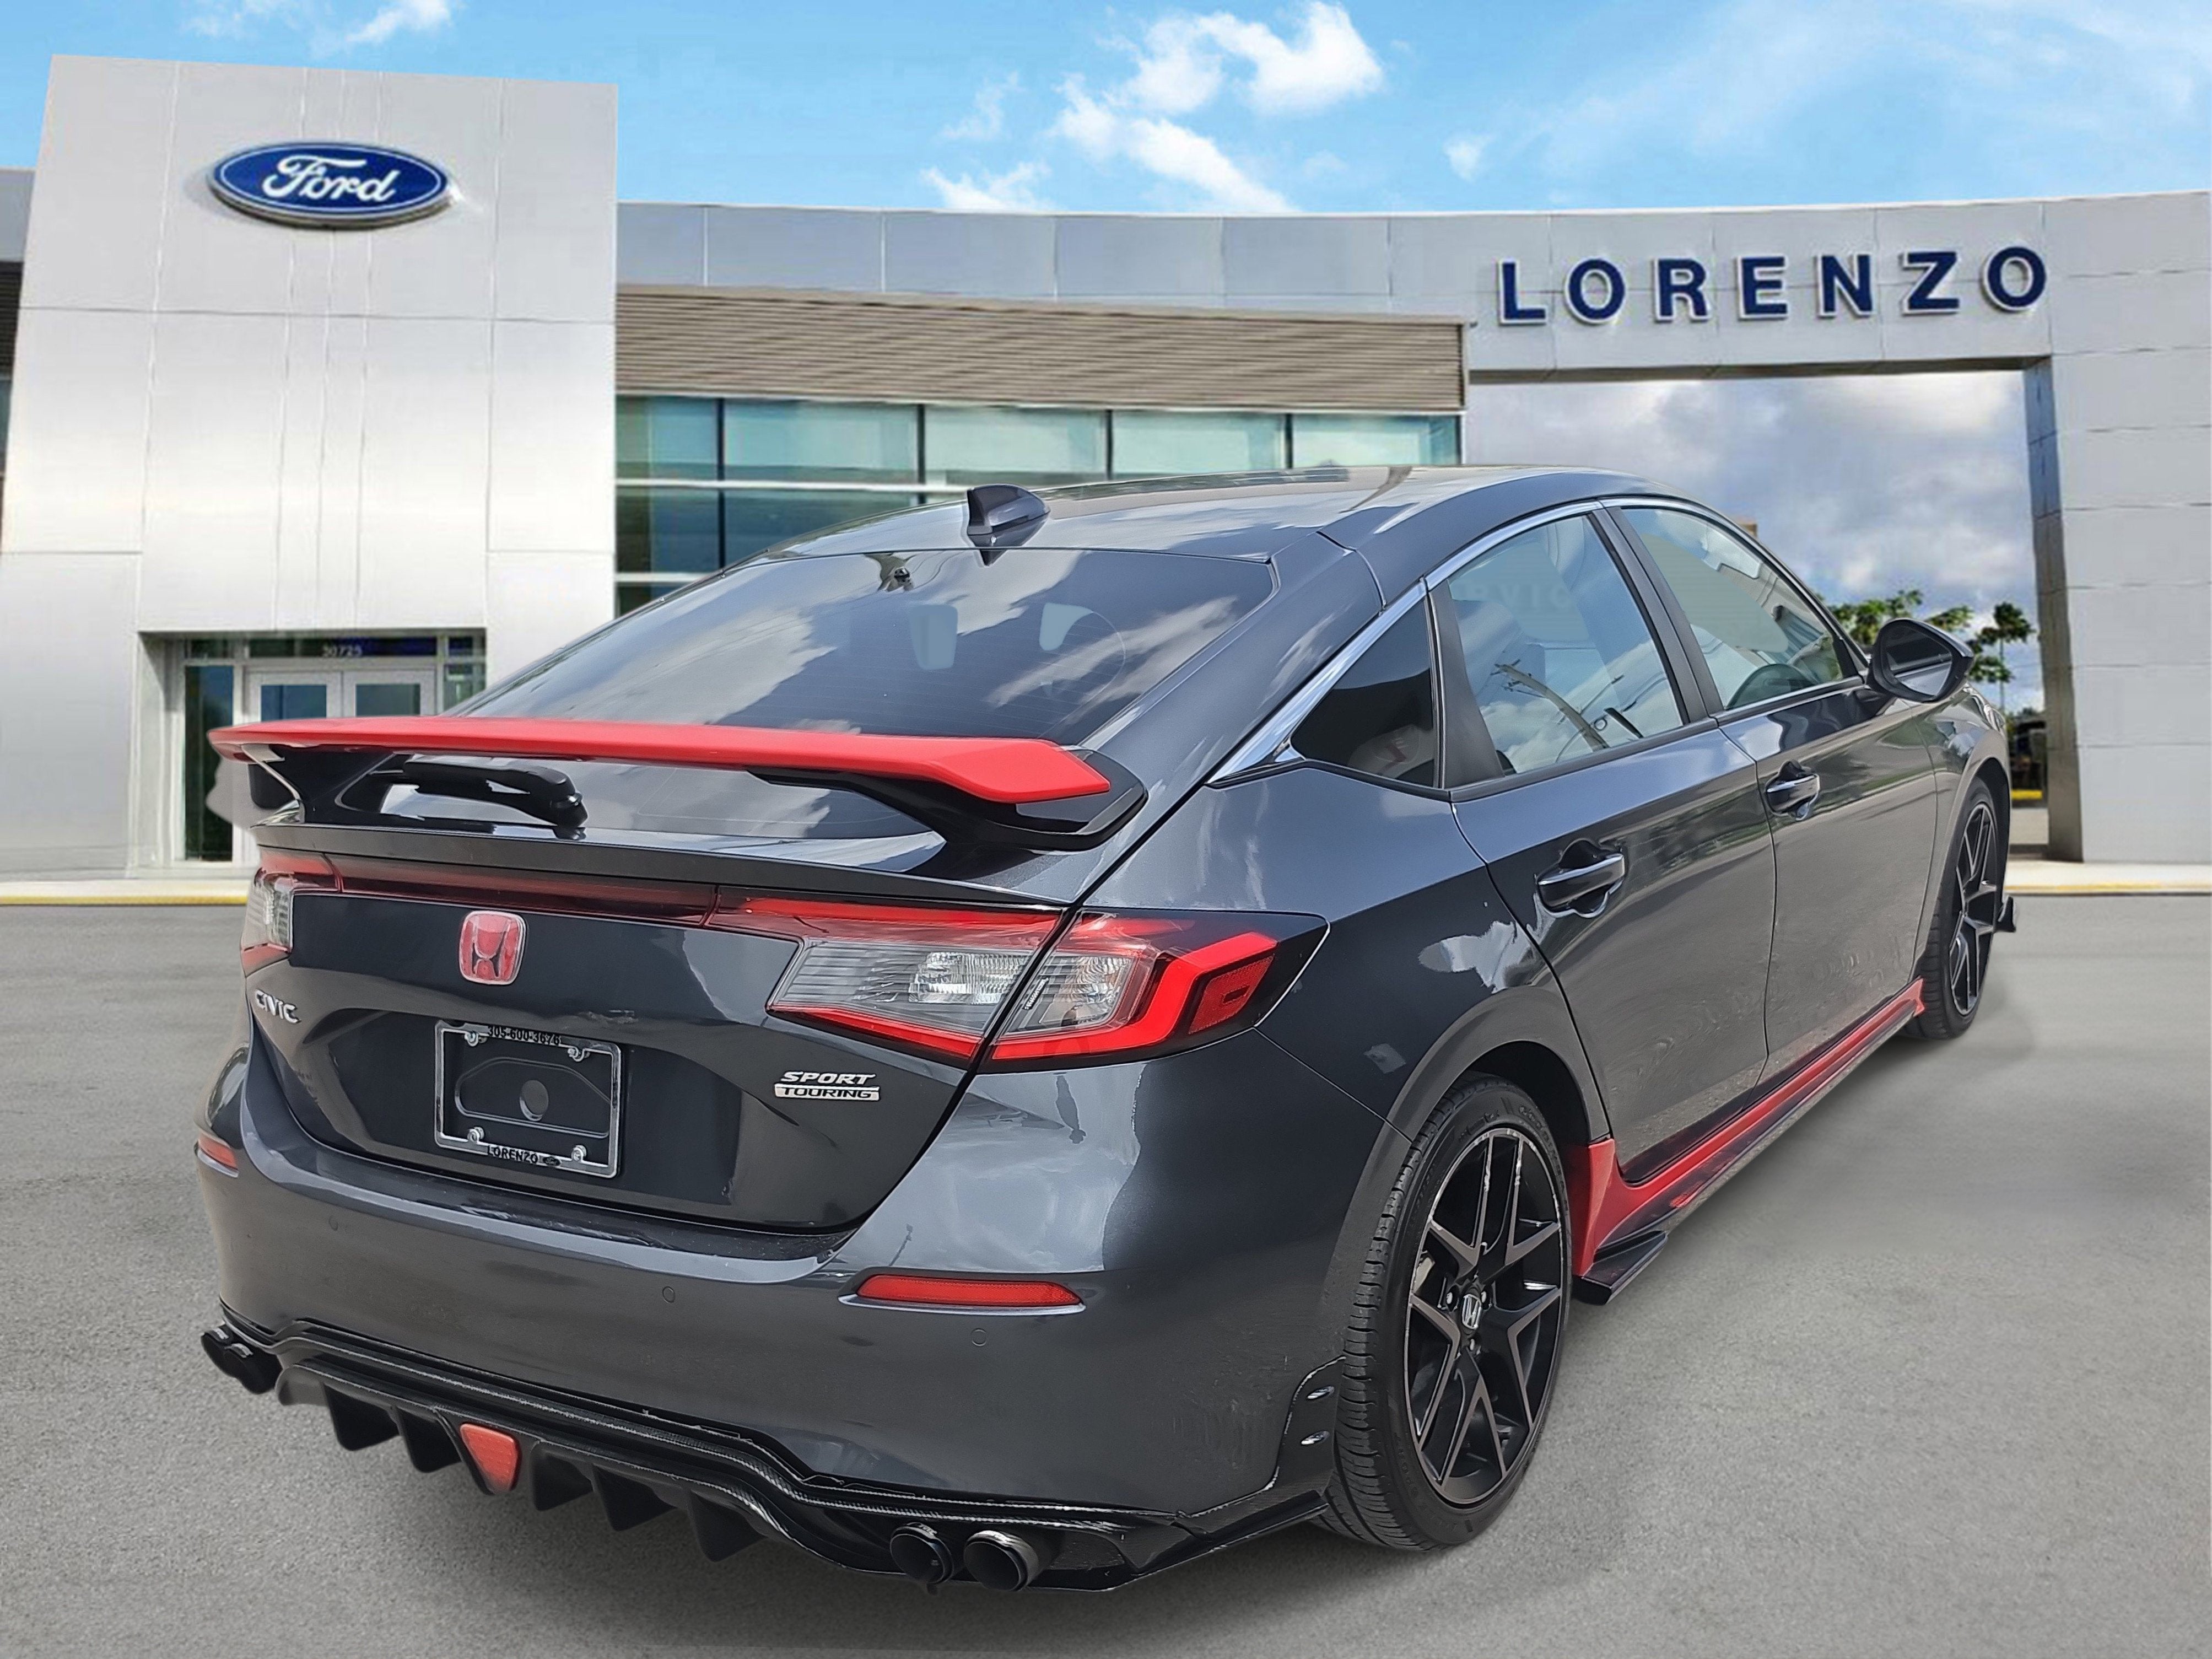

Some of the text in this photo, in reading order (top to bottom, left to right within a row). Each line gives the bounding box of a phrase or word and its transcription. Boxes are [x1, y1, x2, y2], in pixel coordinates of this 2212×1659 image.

[261, 154, 401, 202] Ford
[1498, 246, 2047, 325] LORENZO
[255, 989, 300, 1024] CIVIC
[781, 1071, 876, 1085] SPORT
[784, 1087, 872, 1098] TOURING
[487, 1145, 538, 1164] LORENZO
